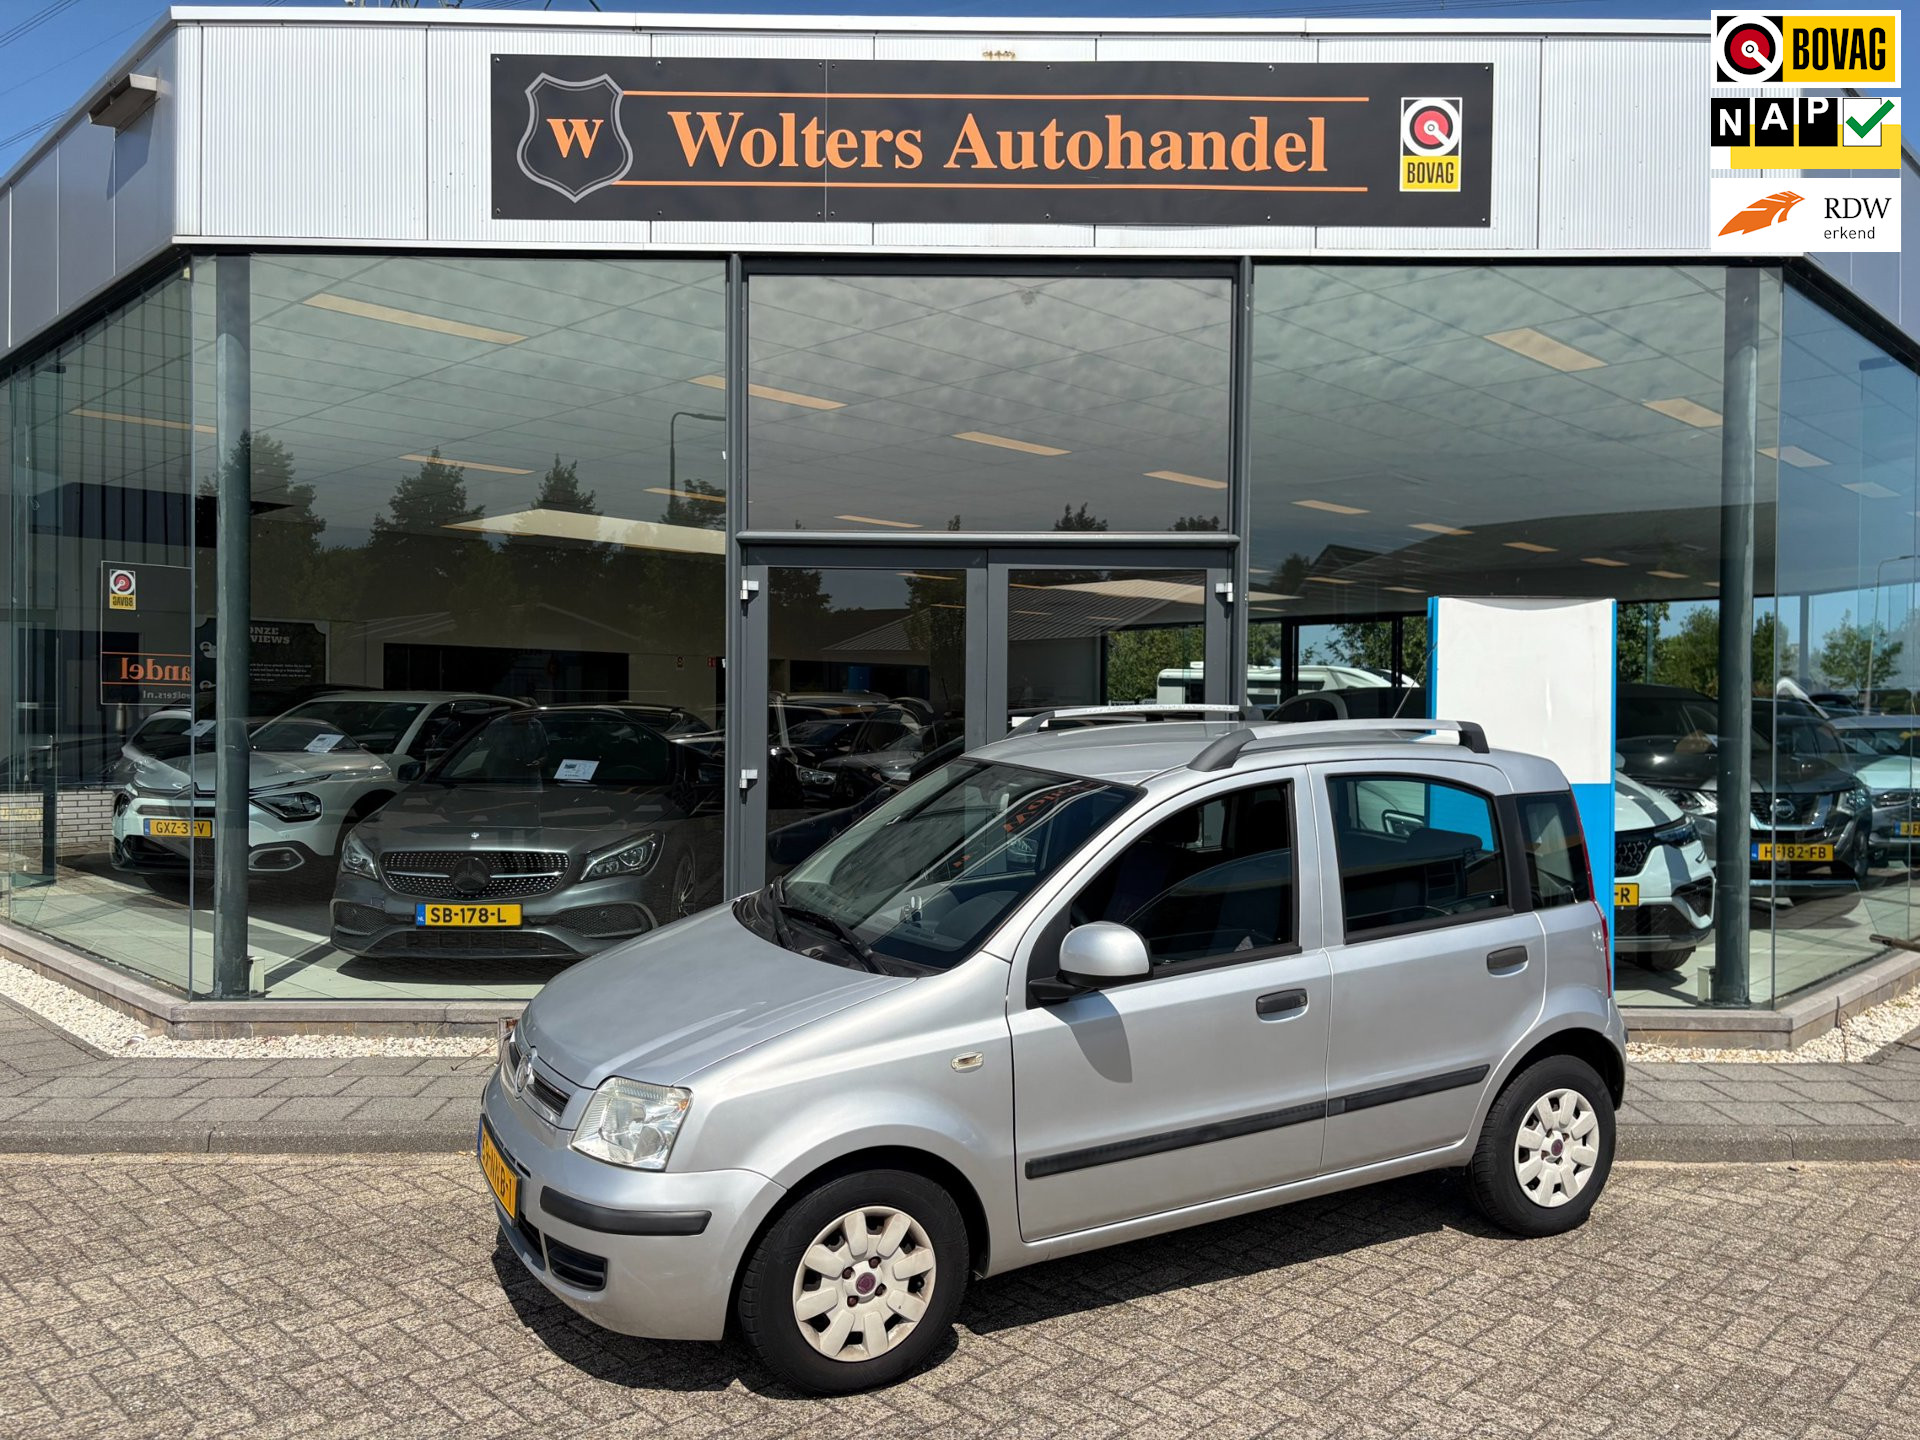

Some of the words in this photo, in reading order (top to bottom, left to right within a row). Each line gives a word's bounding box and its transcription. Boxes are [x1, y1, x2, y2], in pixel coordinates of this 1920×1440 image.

[546, 118, 604, 159] W
[667, 111, 923, 169] Wolters
[943, 113, 1328, 173] Autohandel
[1406, 161, 1455, 185] BOVAG
[156, 821, 205, 834] GXZ-3-V
[430, 907, 507, 924] SB-178-L
